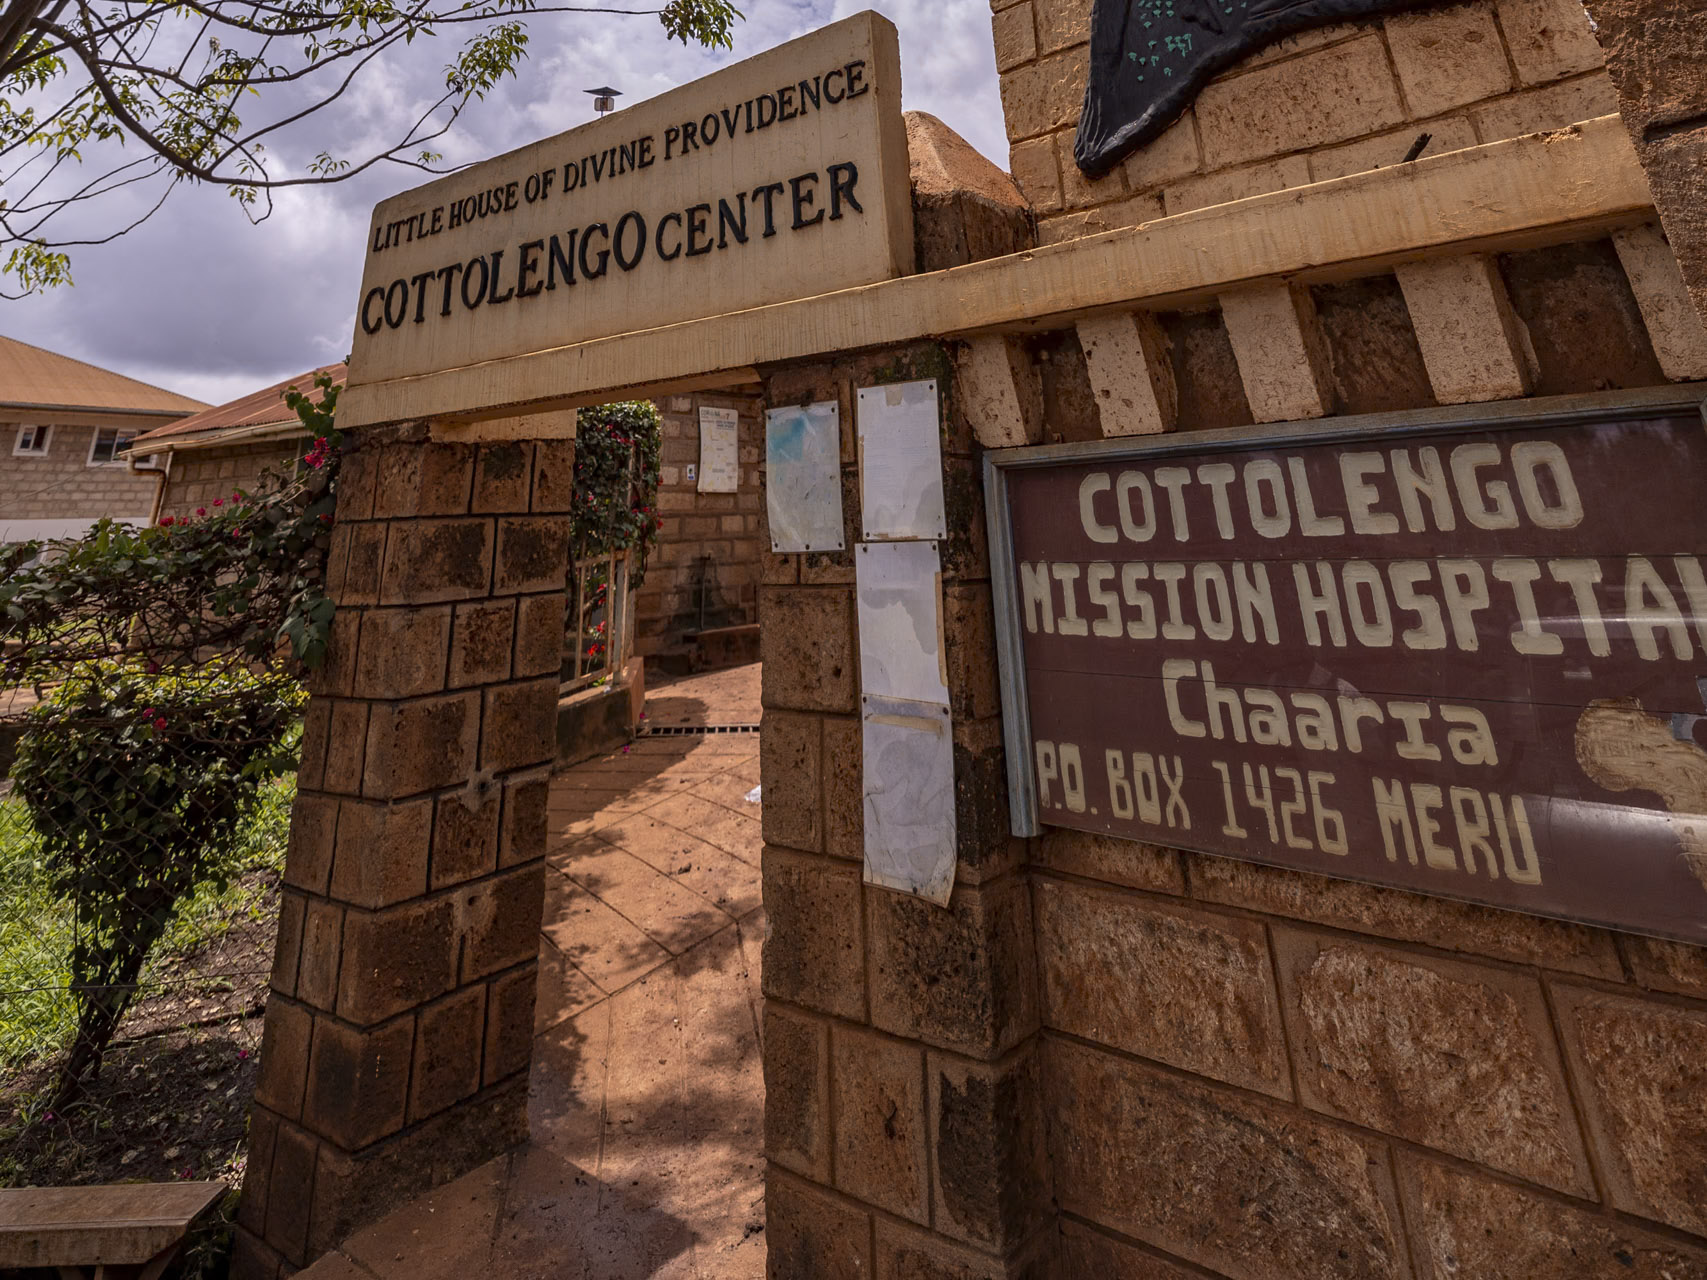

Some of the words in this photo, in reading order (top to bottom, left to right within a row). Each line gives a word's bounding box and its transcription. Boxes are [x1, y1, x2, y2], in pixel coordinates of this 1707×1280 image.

[373, 206, 444, 252] LITTLE
[448, 181, 519, 228] HOUSE
[524, 168, 556, 204] OF
[563, 136, 655, 194] DIVINE
[665, 61, 869, 160] PROVIDENCE
[361, 211, 647, 335] COTTOLENGO
[656, 161, 863, 261] CENTER
[1079, 441, 1584, 543] COTTOLENGO
[1021, 560, 1280, 645] MISSION
[1106, 749, 1191, 830] BOX
[1213, 761, 1349, 856] 1426
[1372, 777, 1542, 884] MERU
